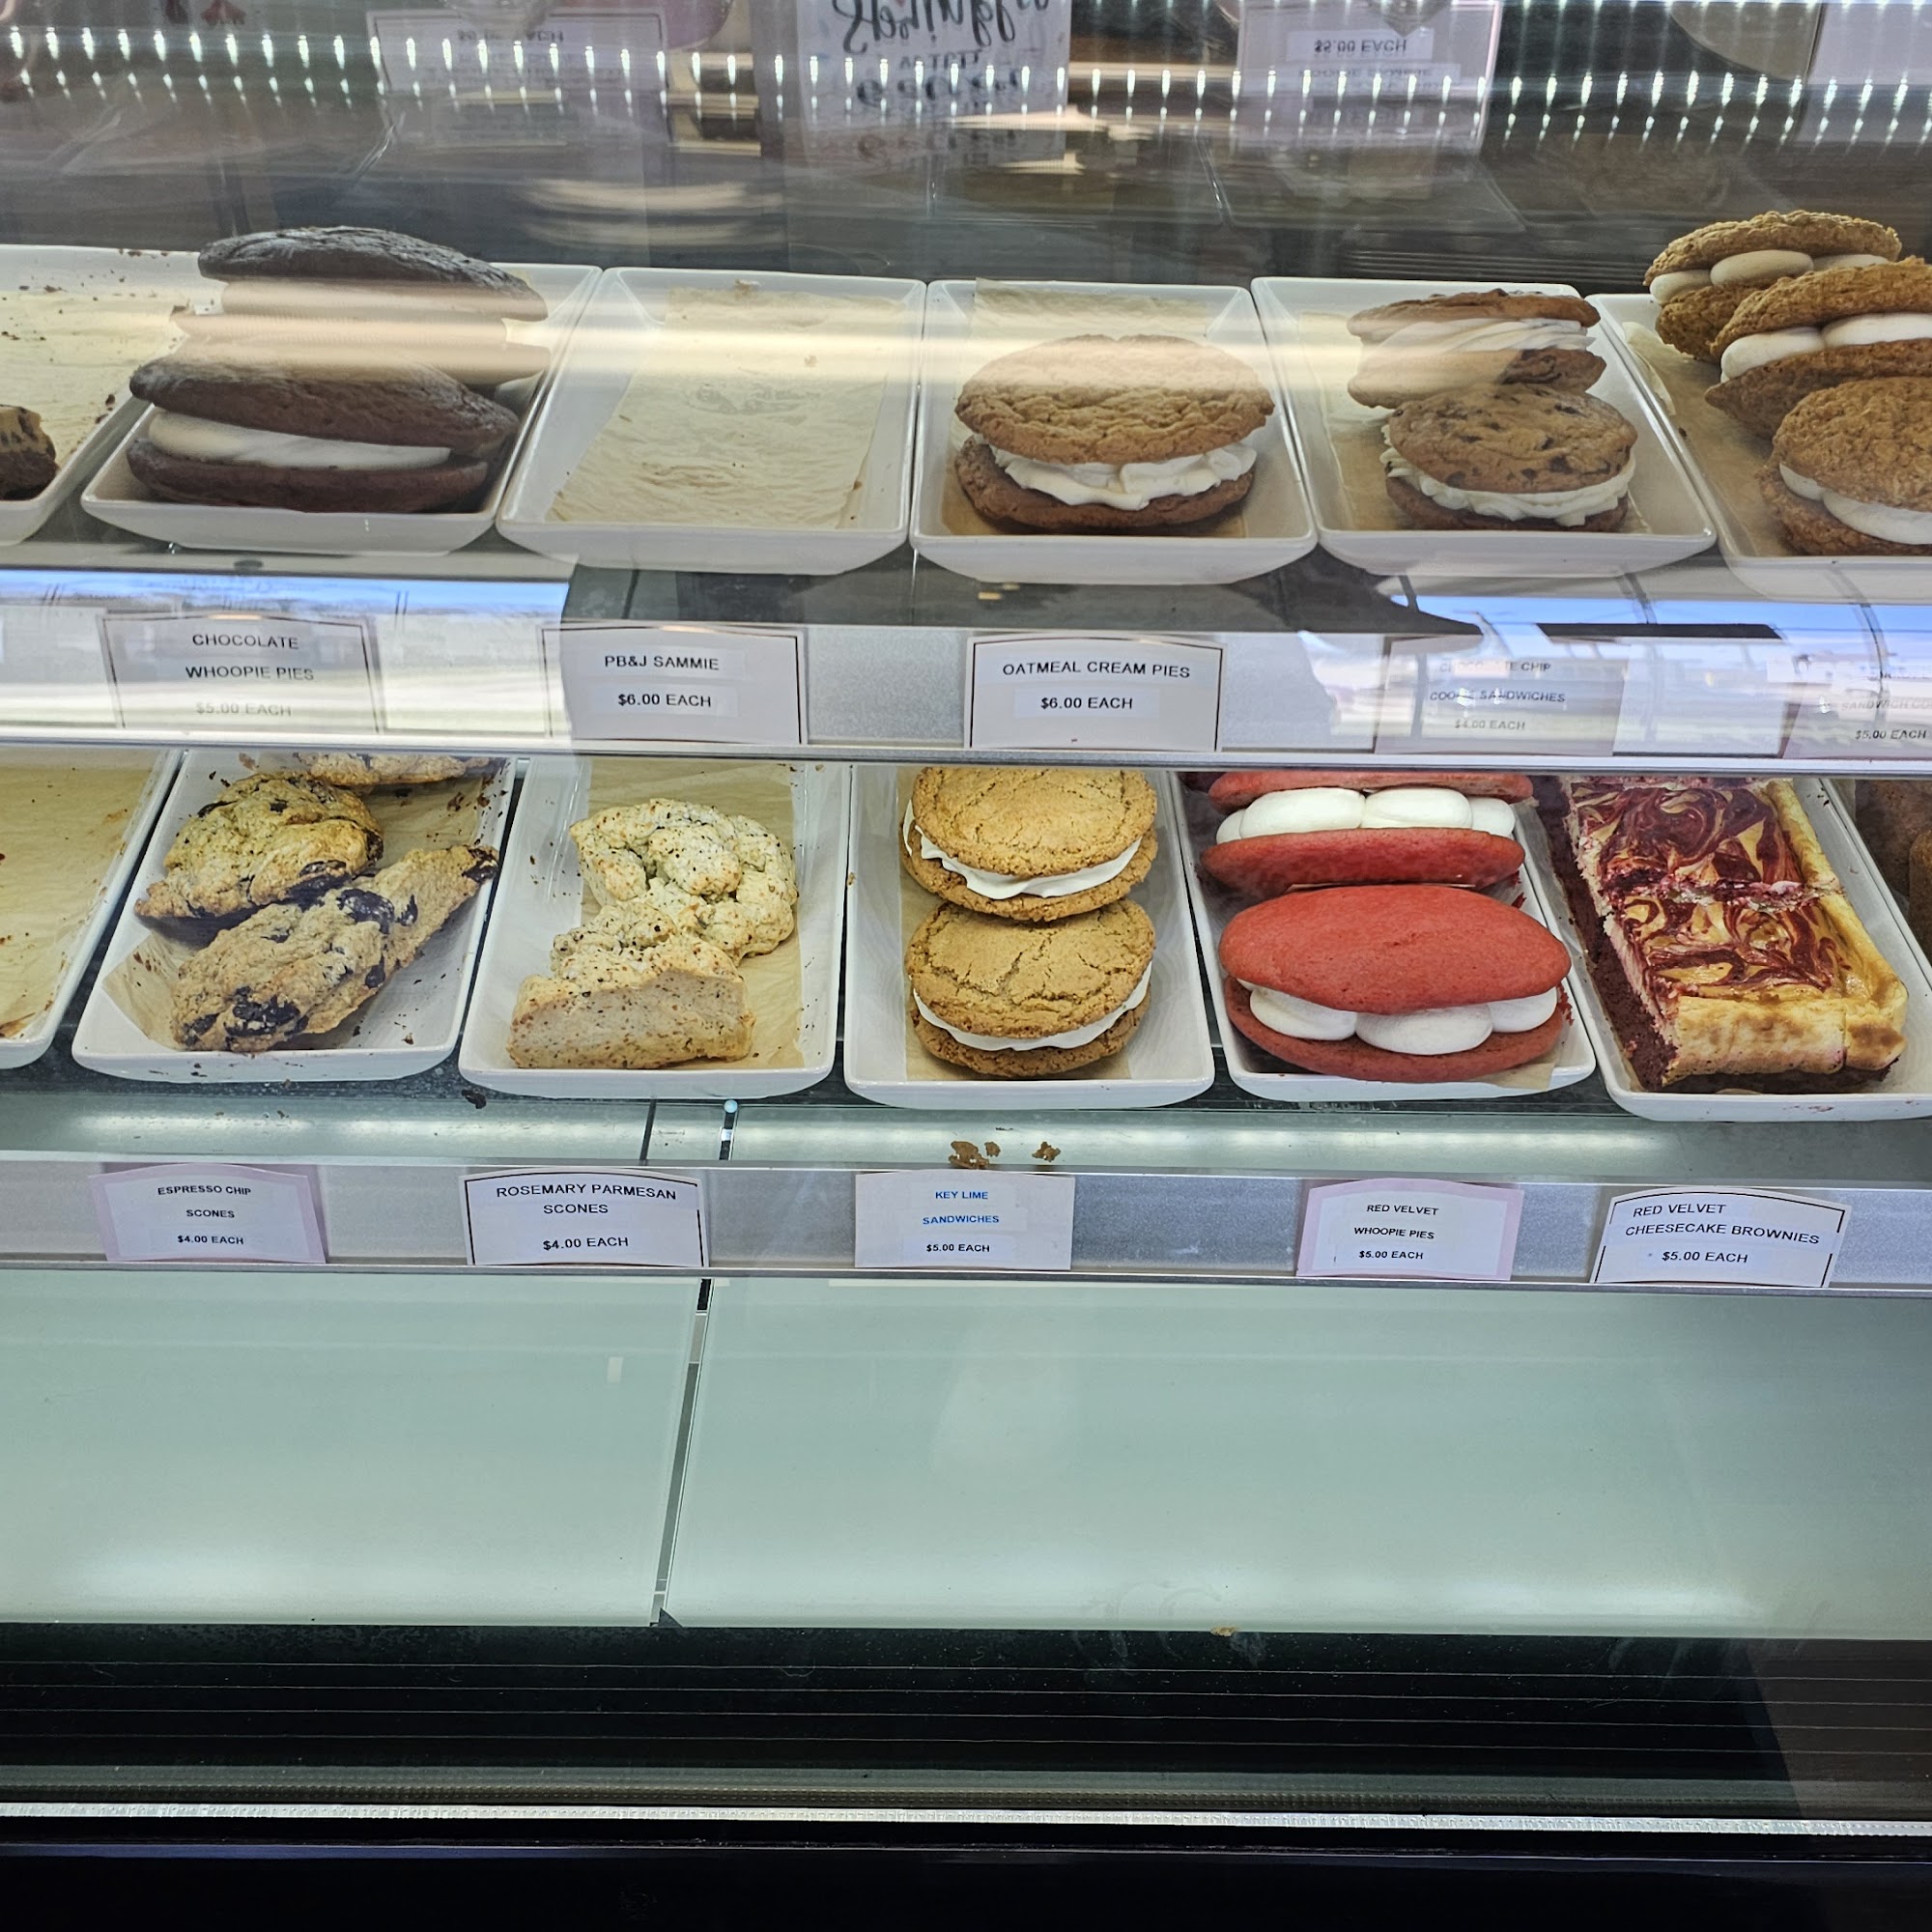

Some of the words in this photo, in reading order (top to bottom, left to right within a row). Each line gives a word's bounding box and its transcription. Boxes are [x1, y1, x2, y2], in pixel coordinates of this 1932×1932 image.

[192, 634, 298, 649] CHOCOLATE
[605, 655, 647, 668] PB&J
[653, 656, 720, 670] SAMMIE
[1520, 662, 1551, 672] CHIP
[185, 667, 270, 679] WHOOPIE
[276, 668, 314, 680] PIES
[1003, 661, 1081, 675] OATMEAL
[1087, 662, 1146, 675] CREAM
[1151, 664, 1190, 678] PIES
[618, 694, 660, 706] $6.00
[666, 694, 711, 707] EACH
[1040, 697, 1082, 710] $6.00
[1088, 697, 1132, 709] EACH
[196, 702, 240, 715] $5.00
[245, 702, 292, 716] EACH
[1490, 720, 1525, 730] EACH
[1855, 729, 1886, 740] $5.00
[1890, 729, 1926, 740] EACH
[157, 1185, 223, 1196] ESPRESSO
[226, 1186, 251, 1196] CHIP
[497, 1183, 586, 1197] ROSEMARY
[591, 1184, 677, 1200] PARMESAN
[935, 1191, 958, 1200] KEY
[962, 1191, 988, 1200] LIME
[186, 1208, 235, 1218] SCONES
[543, 1204, 609, 1214] SCONES
[1366, 1204, 1390, 1212] RED
[1394, 1205, 1439, 1215] VELVET
[1633, 1205, 1662, 1217] RED
[1668, 1203, 1727, 1214] VELVET
[923, 1215, 1000, 1225] SANDWICHES
[1354, 1227, 1406, 1237] WHOOPIE
[1409, 1230, 1435, 1239] PIES
[1625, 1223, 1727, 1236] CHEESECAKE
[1731, 1225, 1820, 1244] BROWNIES
[177, 1235, 208, 1244] $4.00
[212, 1236, 244, 1245] EACH
[543, 1238, 582, 1251] $4.00
[586, 1236, 629, 1247] EACH
[926, 1243, 954, 1253] $5.00
[958, 1243, 990, 1253] EACH
[1358, 1250, 1388, 1259] $5.00
[1391, 1250, 1424, 1260] EACH
[1662, 1251, 1700, 1262] $5.00
[1705, 1252, 1748, 1264] EACH
